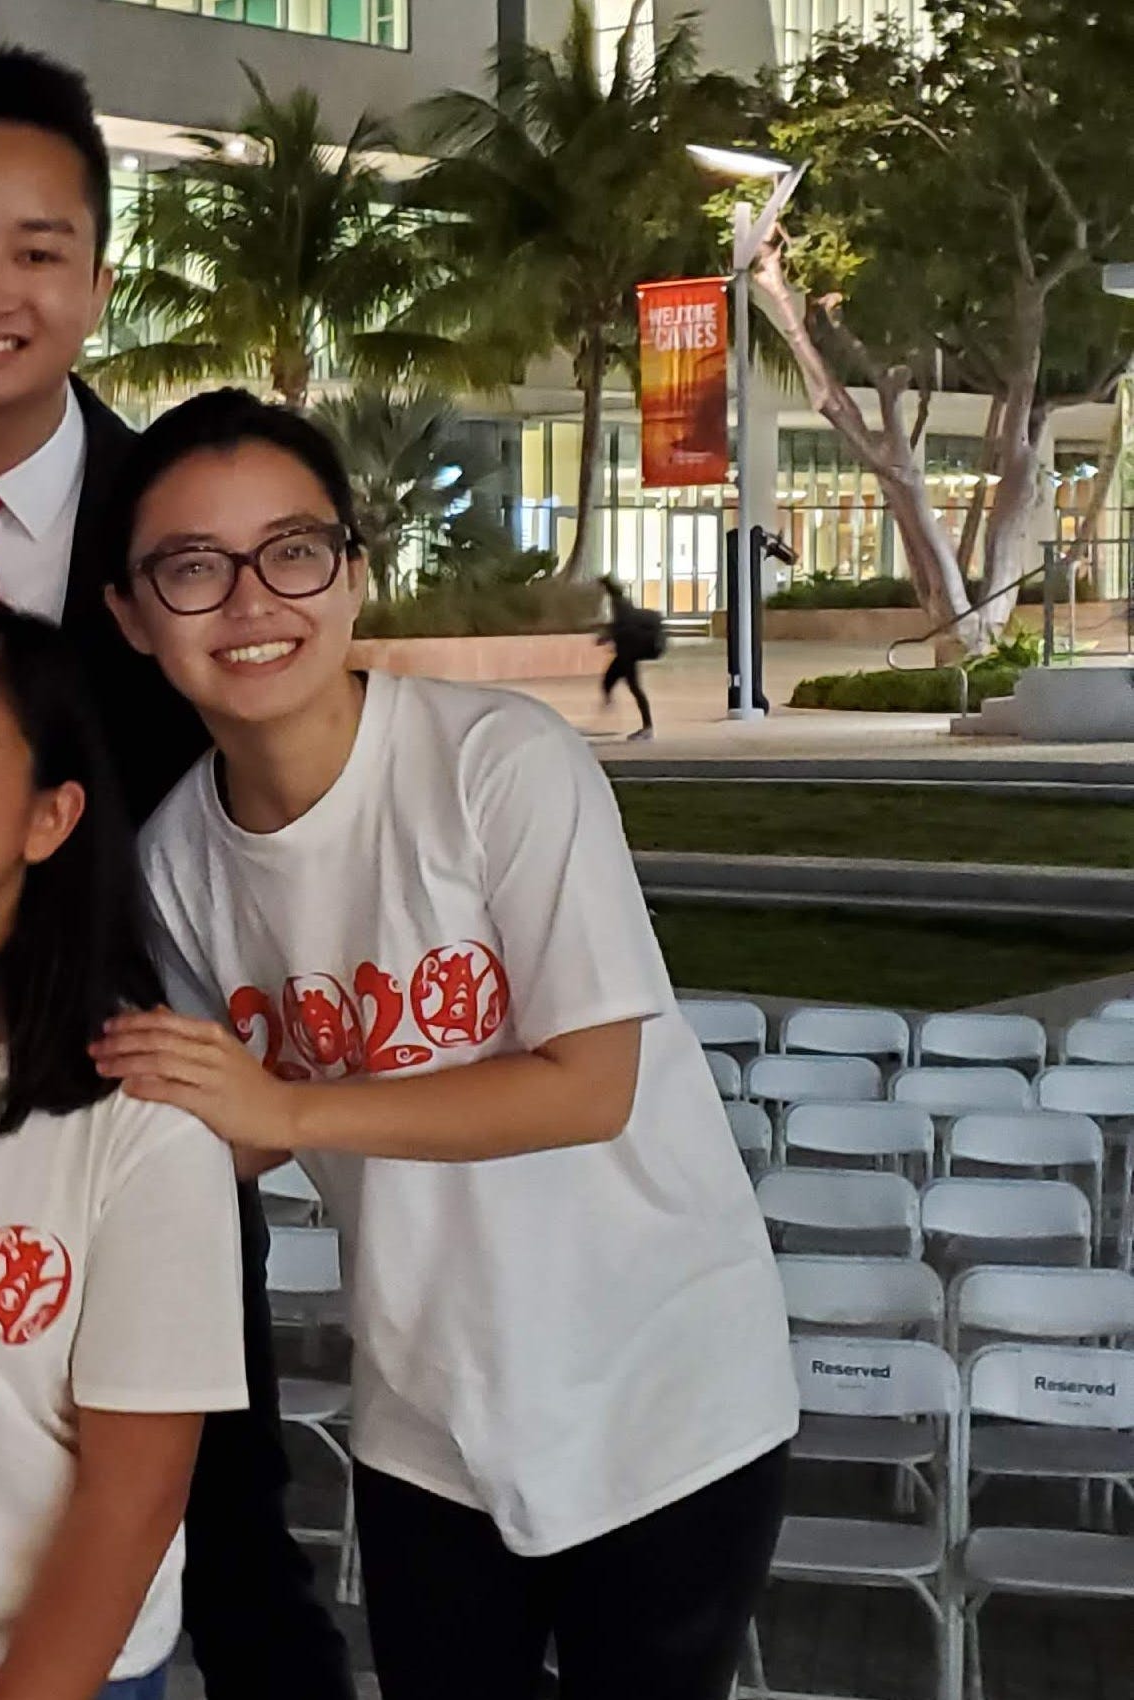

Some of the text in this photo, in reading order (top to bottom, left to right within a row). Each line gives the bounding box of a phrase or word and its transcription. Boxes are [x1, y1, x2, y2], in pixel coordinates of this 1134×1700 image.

[229, 939, 510, 1081] 2020
[811, 1359, 891, 1379] Reserved
[1034, 1376, 1116, 1397] Reserved
